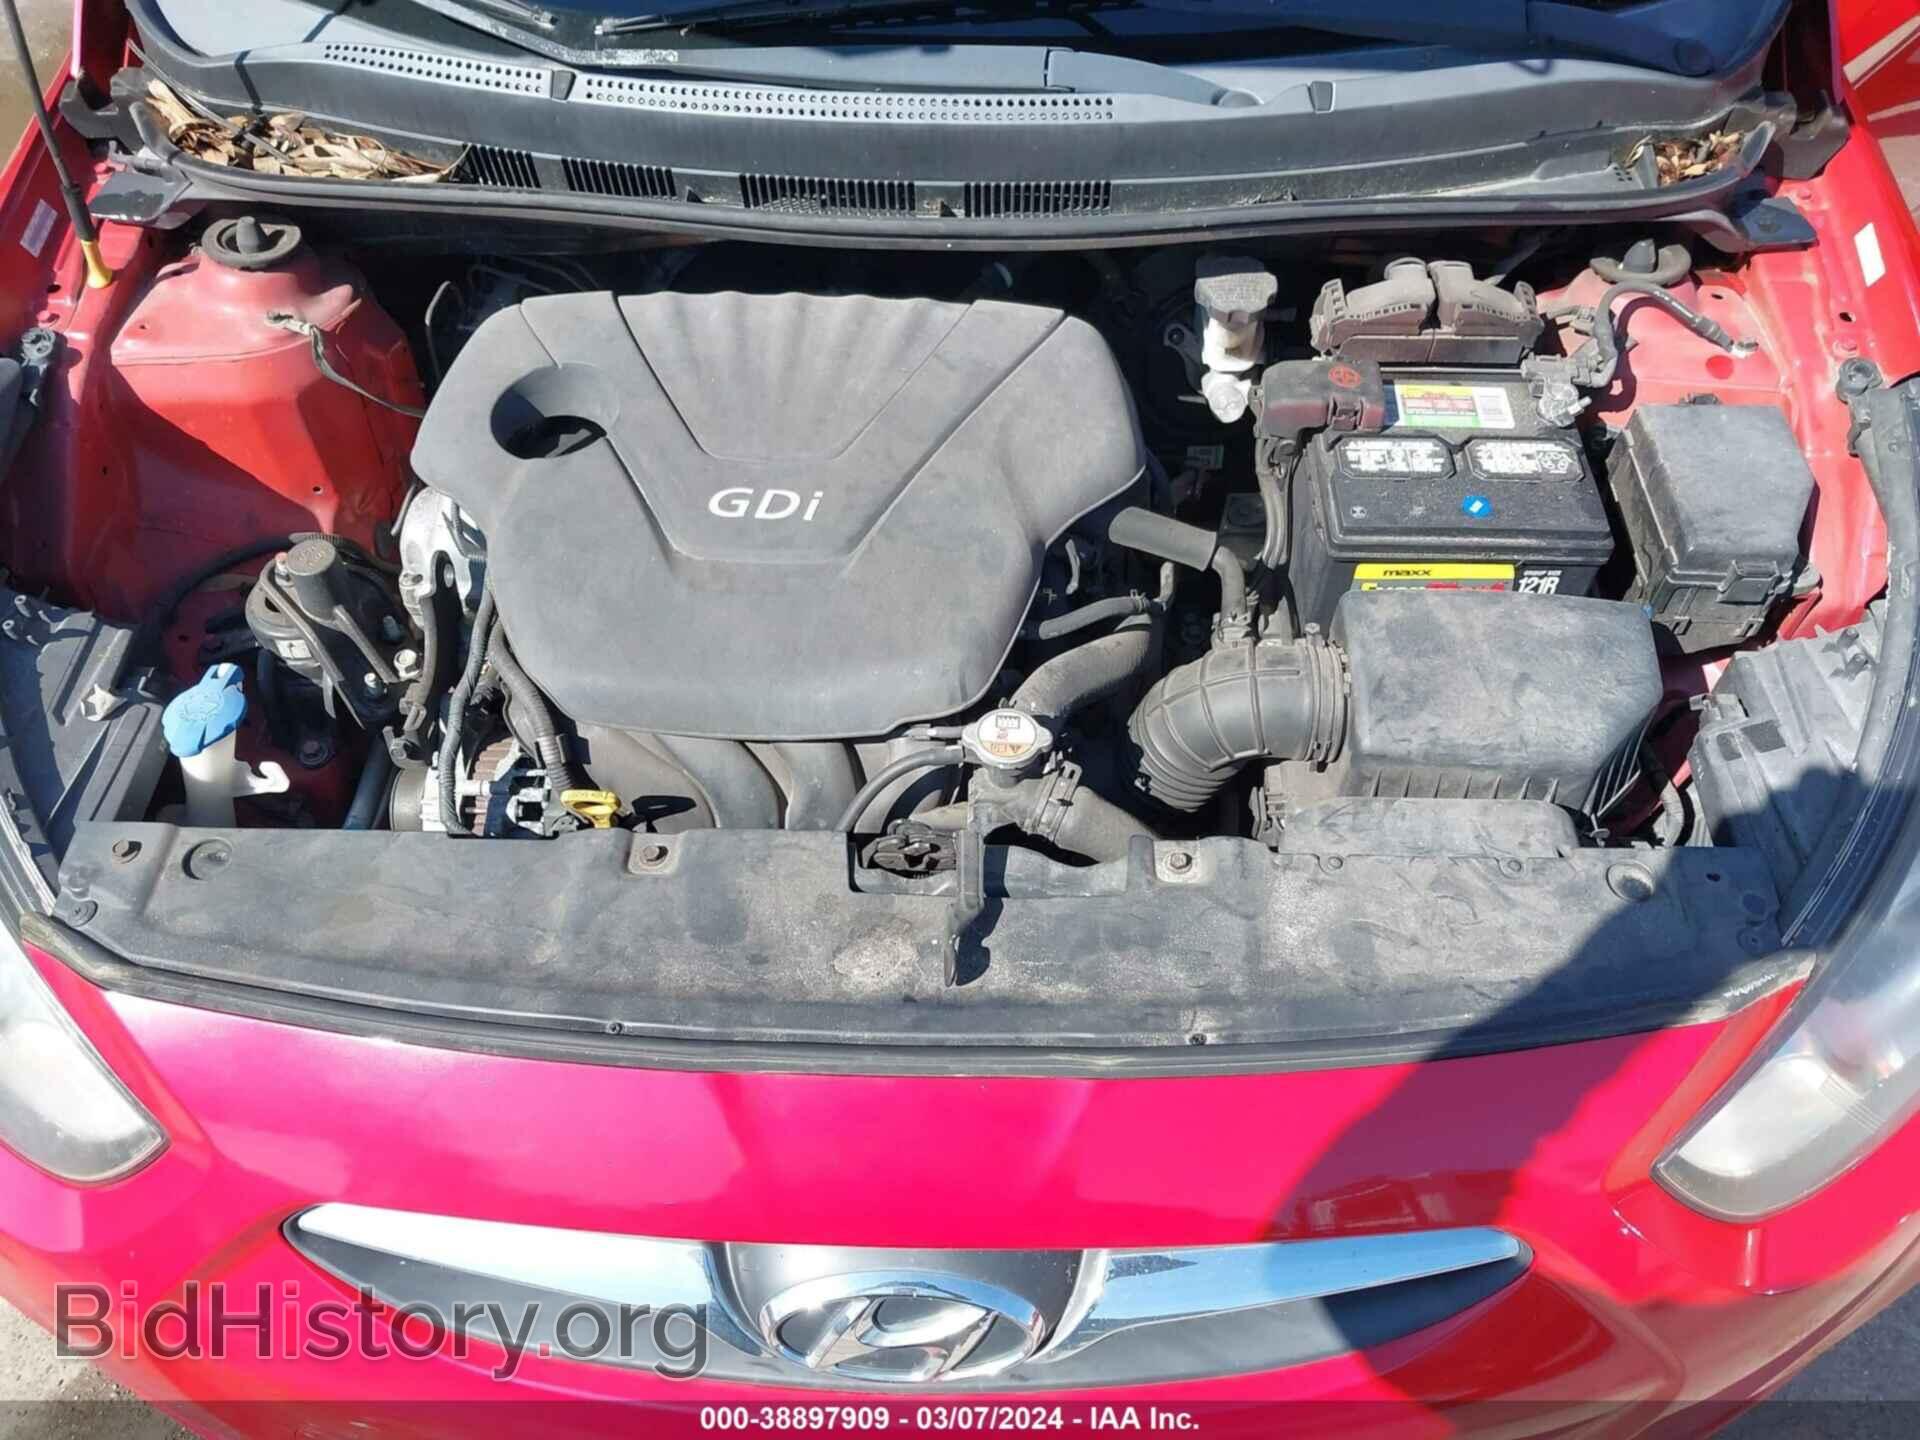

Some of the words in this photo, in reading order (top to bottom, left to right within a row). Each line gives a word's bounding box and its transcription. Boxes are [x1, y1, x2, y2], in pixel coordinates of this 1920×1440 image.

[708, 487, 824, 521] GDi
[1383, 568, 1432, 577] maxx
[1518, 576, 1560, 595] 121R
